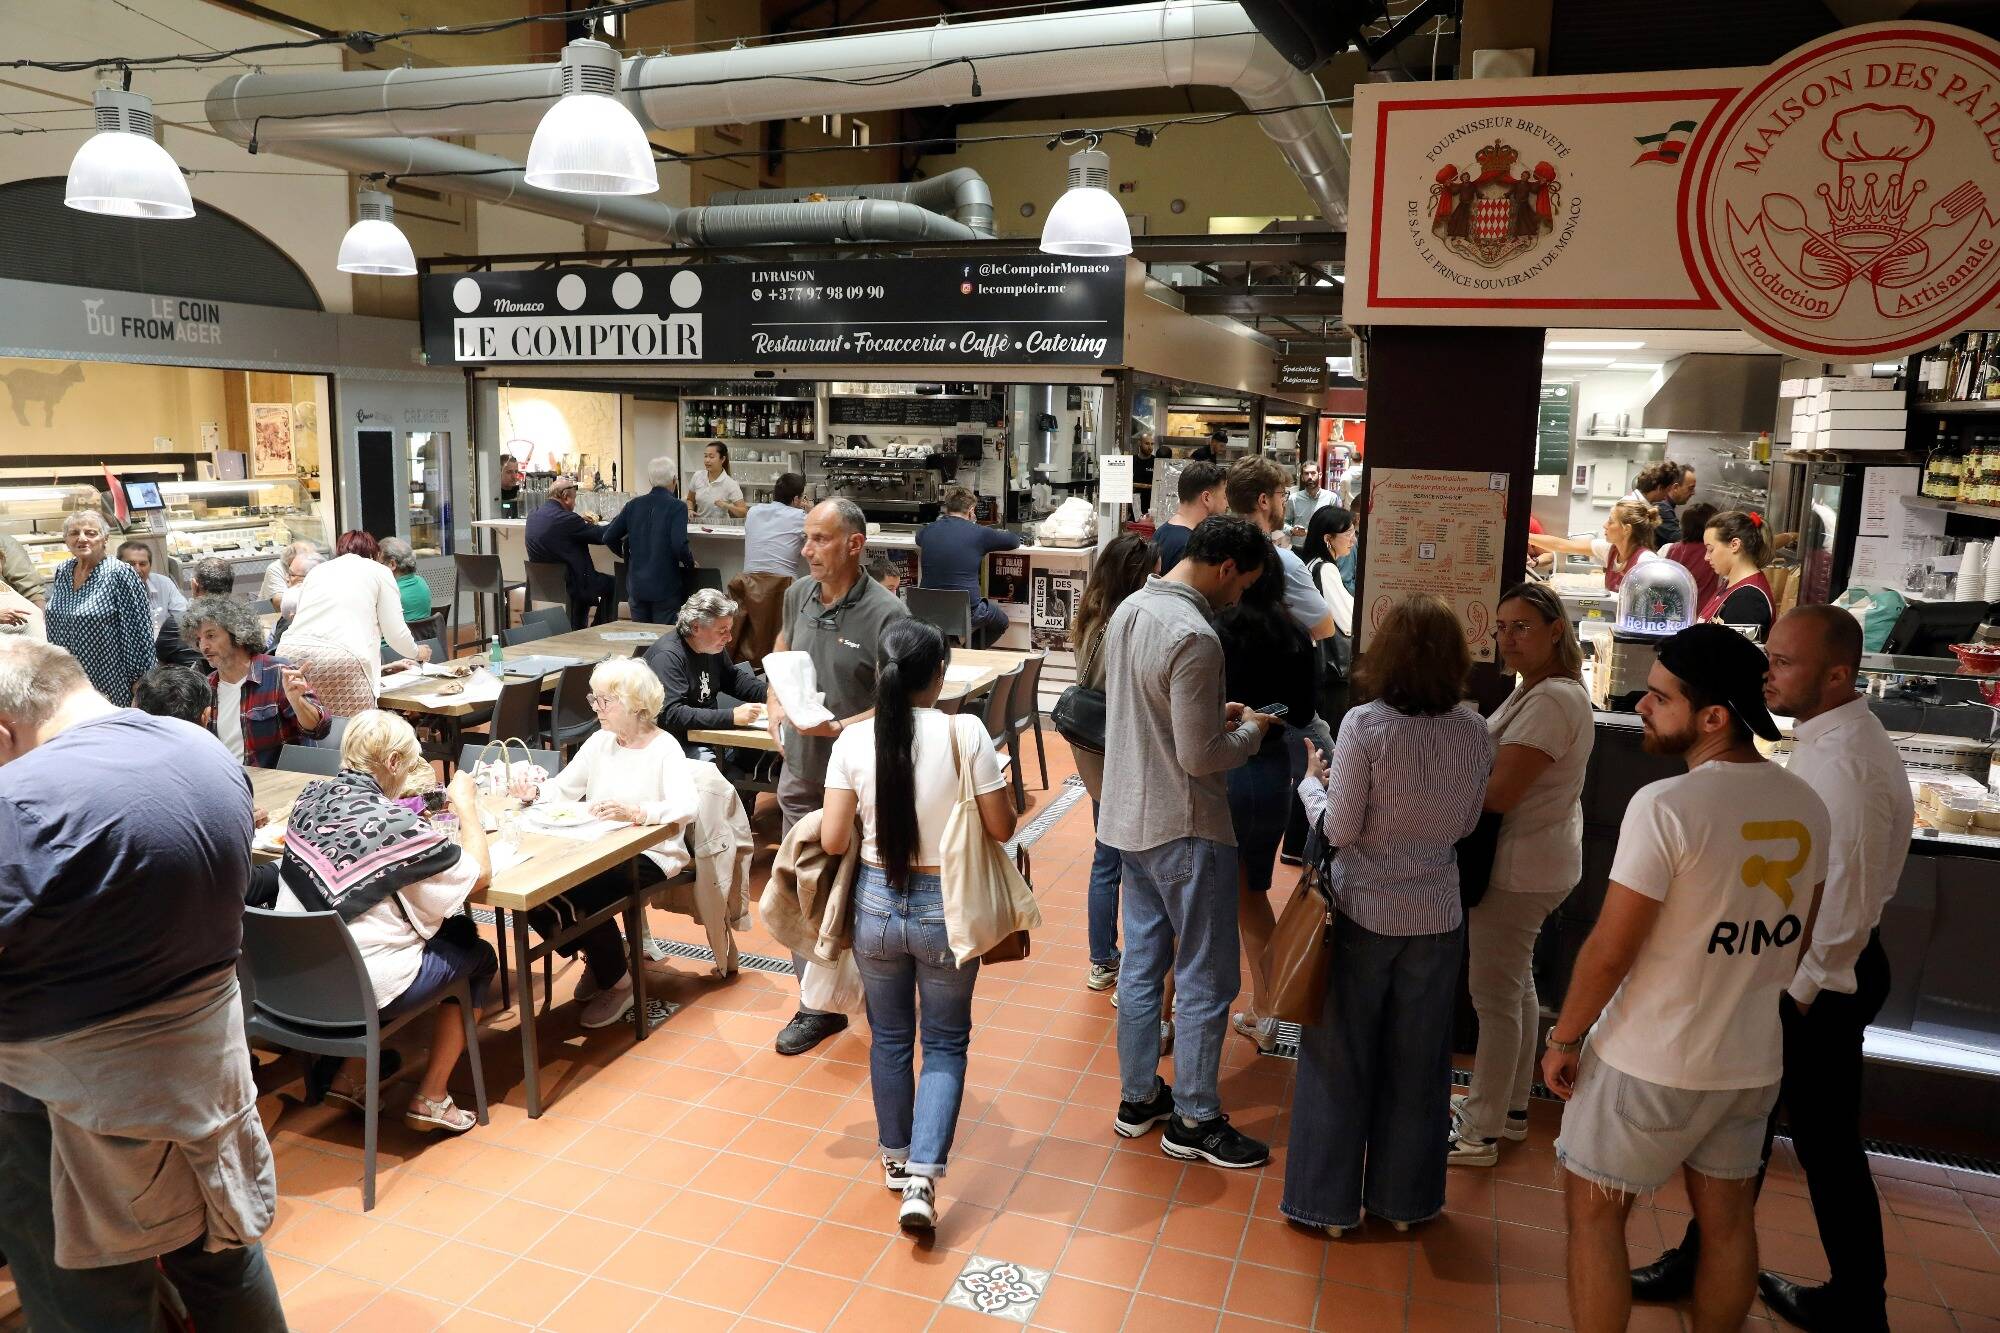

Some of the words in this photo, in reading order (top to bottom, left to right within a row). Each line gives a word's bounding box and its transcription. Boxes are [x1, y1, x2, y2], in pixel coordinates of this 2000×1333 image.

[1733, 68, 1853, 176] MAISON
[1864, 62, 1940, 91] DES
[1425, 116, 1513, 163] FOURNISSEUR
[1516, 118, 1571, 159] BREVETÉ
[1420, 247, 1433, 264] LE
[1432, 260, 1472, 287] PRINCE
[1473, 262, 1543, 290] SOUVERAIN
[1541, 252, 1559, 268] DE
[1555, 196, 1582, 254] MONACO
[751, 270, 815, 283] LIVRAISON
[979, 262, 1110, 277] @leComptoirMonaco
[1740, 244, 1830, 314] Production
[1895, 237, 1994, 314] Artisanale
[768, 287, 804, 301] +377
[806, 286, 823, 300] 97
[826, 286, 843, 300] 98
[846, 285, 864, 300] 09
[867, 285, 885, 299] 90
[978, 282, 1067, 297] lecomptoir.mc
[151, 298, 175, 320] LE
[179, 301, 220, 324] COIN
[493, 298, 545, 313] Monaco
[121, 316, 222, 345] FROMAGER
[458, 326, 497, 357] LE
[511, 322, 699, 357] COMPTOIR
[752, 332, 844, 354] Restaurant
[853, 331, 947, 354] Focacceria
[959, 330, 1011, 358] Caffè
[1026, 330, 1108, 359] Catering
[1036, 579, 1045, 618] ATELIERS
[1056, 580, 1072, 589] DES
[1627, 615, 1689, 631] Heineken
